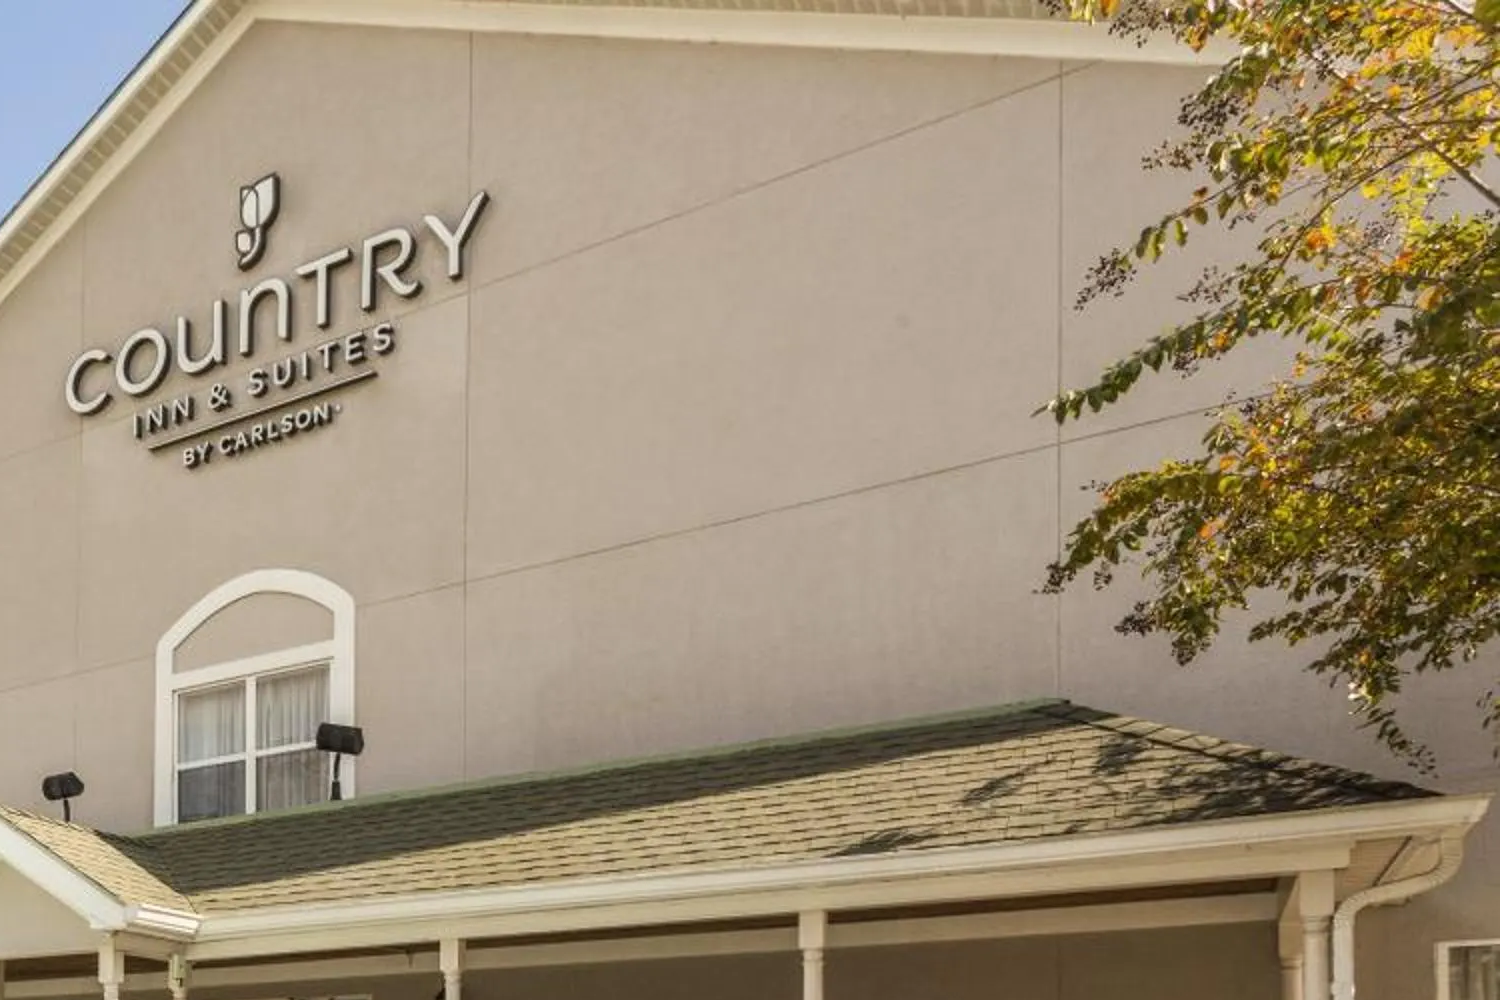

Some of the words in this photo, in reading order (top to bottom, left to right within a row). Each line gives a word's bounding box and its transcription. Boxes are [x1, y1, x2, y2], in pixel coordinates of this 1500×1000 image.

[132, 395, 195, 438] INN
[207, 382, 232, 412] &
[247, 323, 395, 397] SUITES
[182, 441, 214, 468] BY
[219, 403, 331, 455] CARLSON
